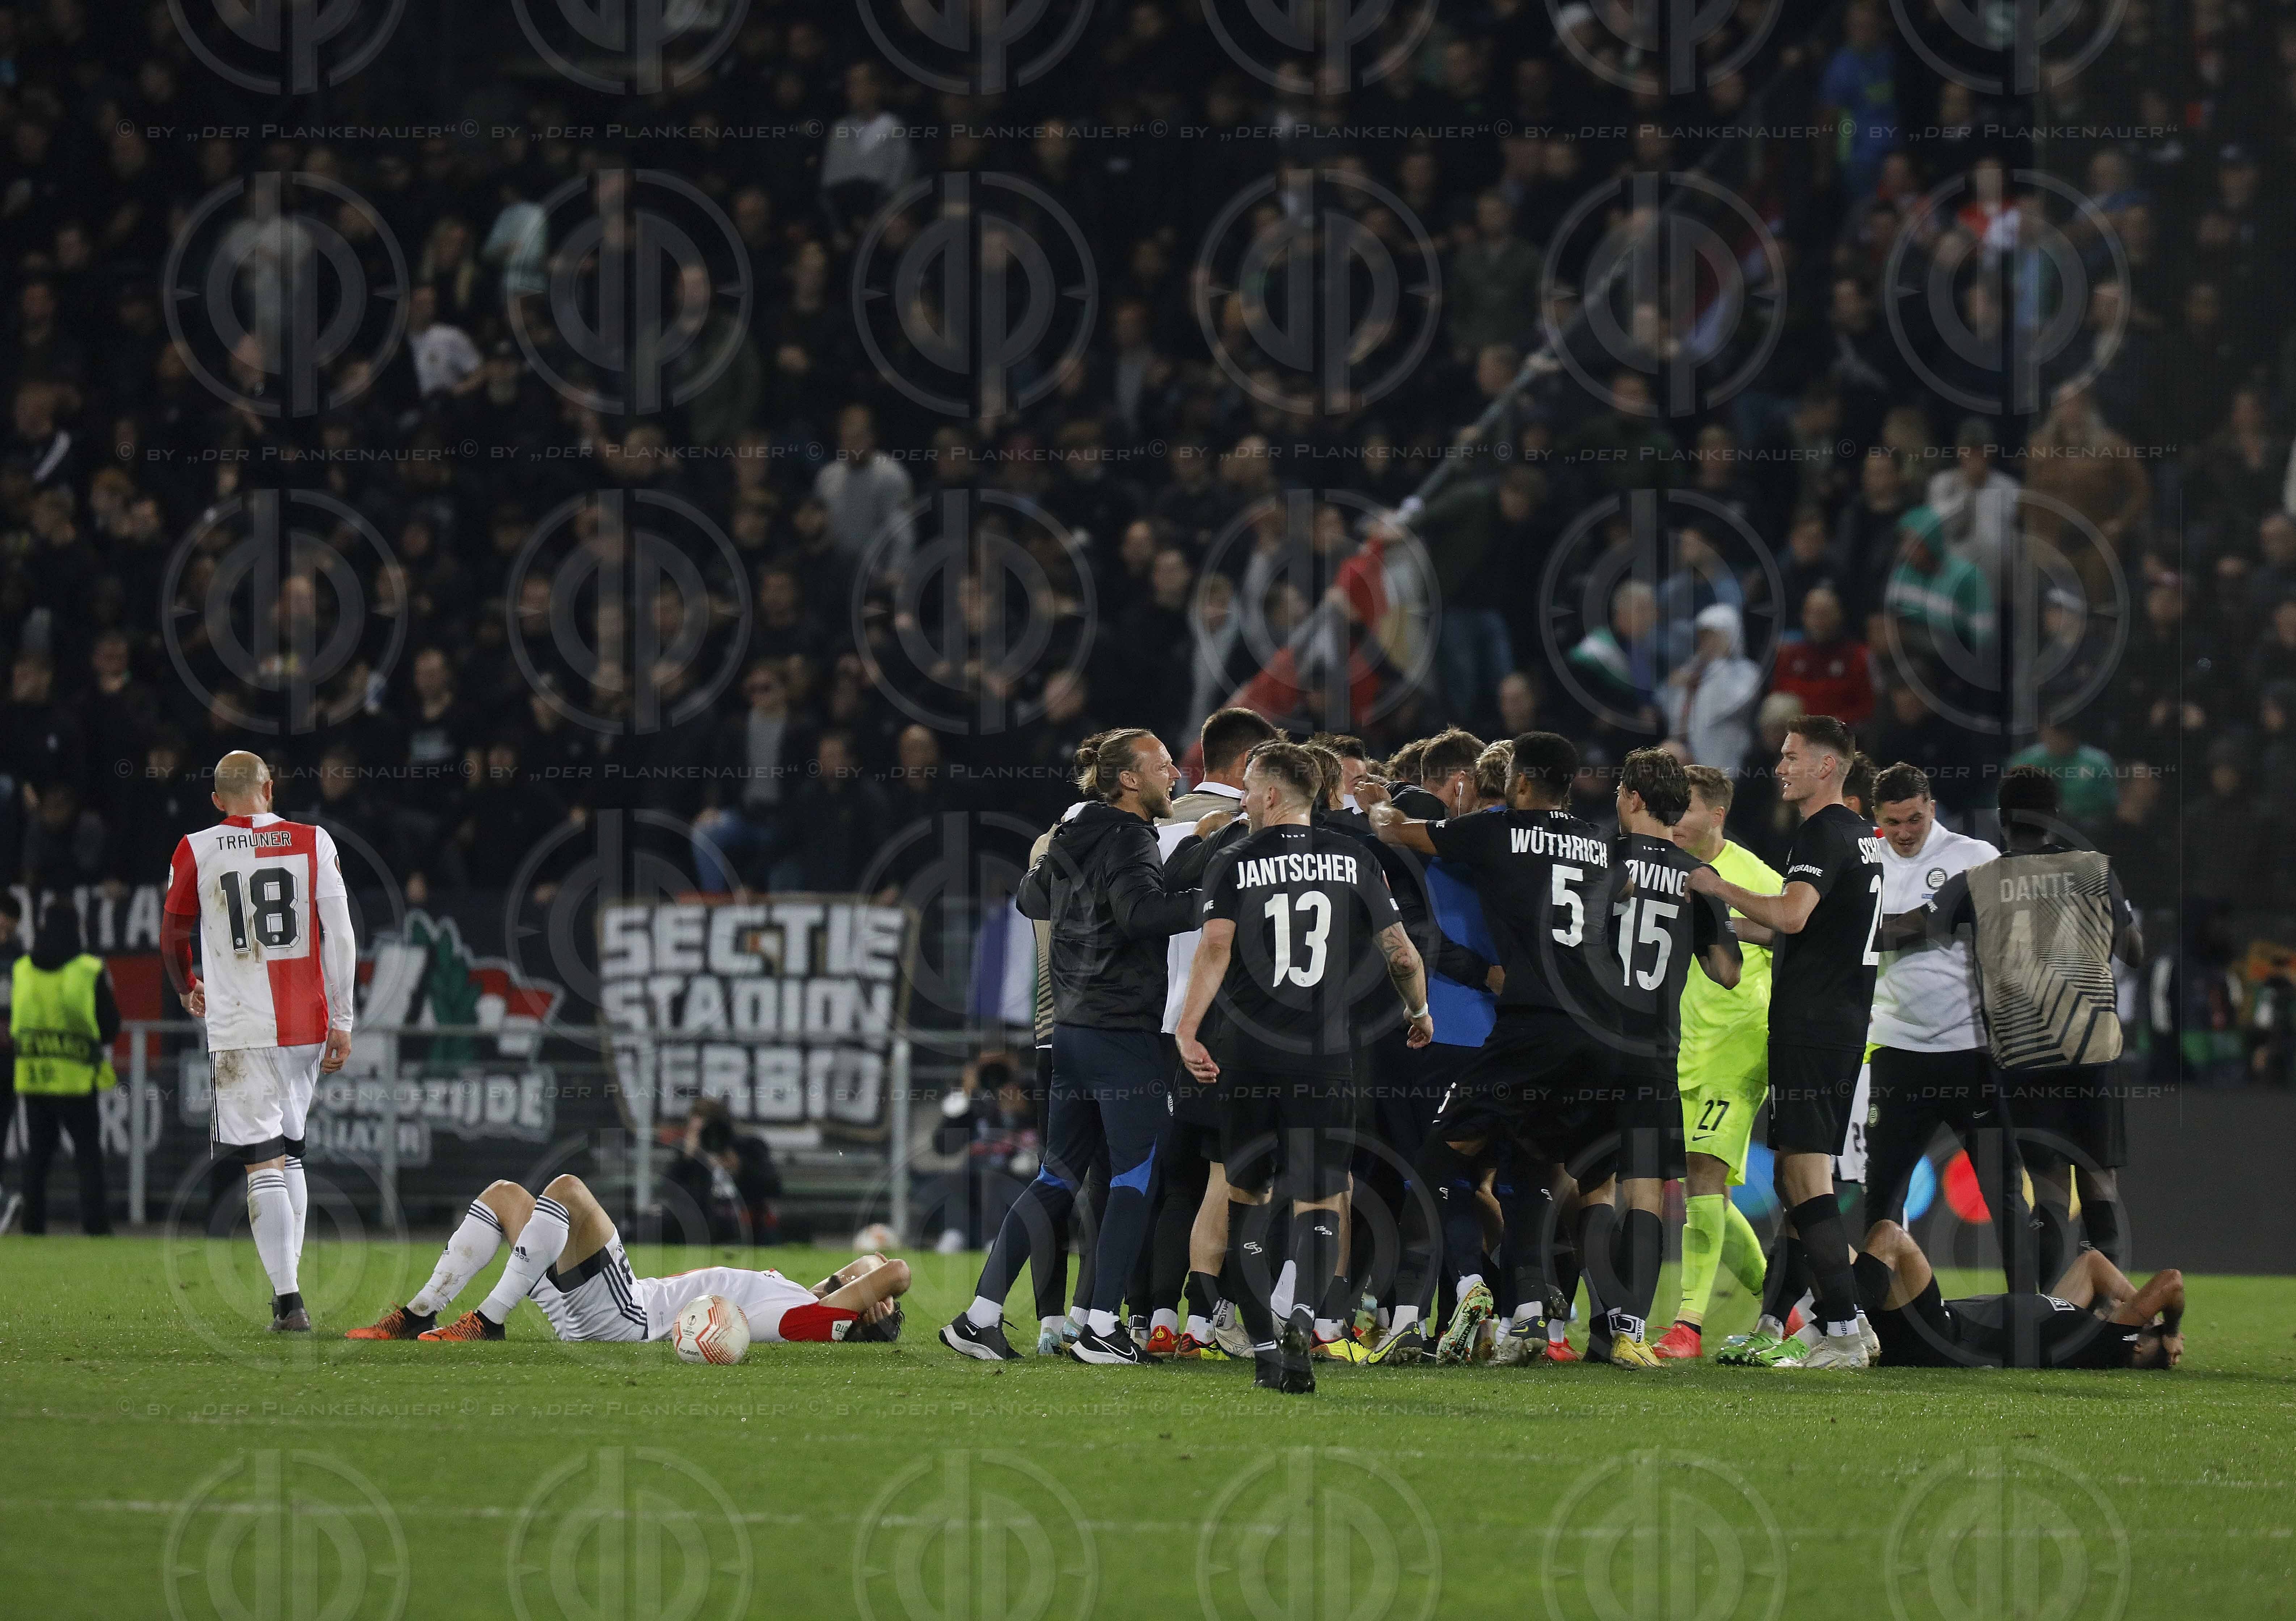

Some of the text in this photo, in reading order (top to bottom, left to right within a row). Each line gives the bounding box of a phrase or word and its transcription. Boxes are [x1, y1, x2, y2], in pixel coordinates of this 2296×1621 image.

[216, 831, 292, 851] TRAUNER
[1511, 826, 1608, 868] WÜTHRICH
[1236, 853, 1358, 890] JANTSCHER
[1624, 859, 1690, 897] ØVING
[2000, 872, 2075, 903] DANTE
[219, 867, 301, 953] 18
[1552, 864, 1584, 947] 5
[601, 904, 905, 979] SECTIE
[1265, 891, 1332, 987] 13
[1613, 897, 1679, 991] 15
[601, 974, 893, 1048] STADION
[1697, 1099, 1730, 1131] 27
